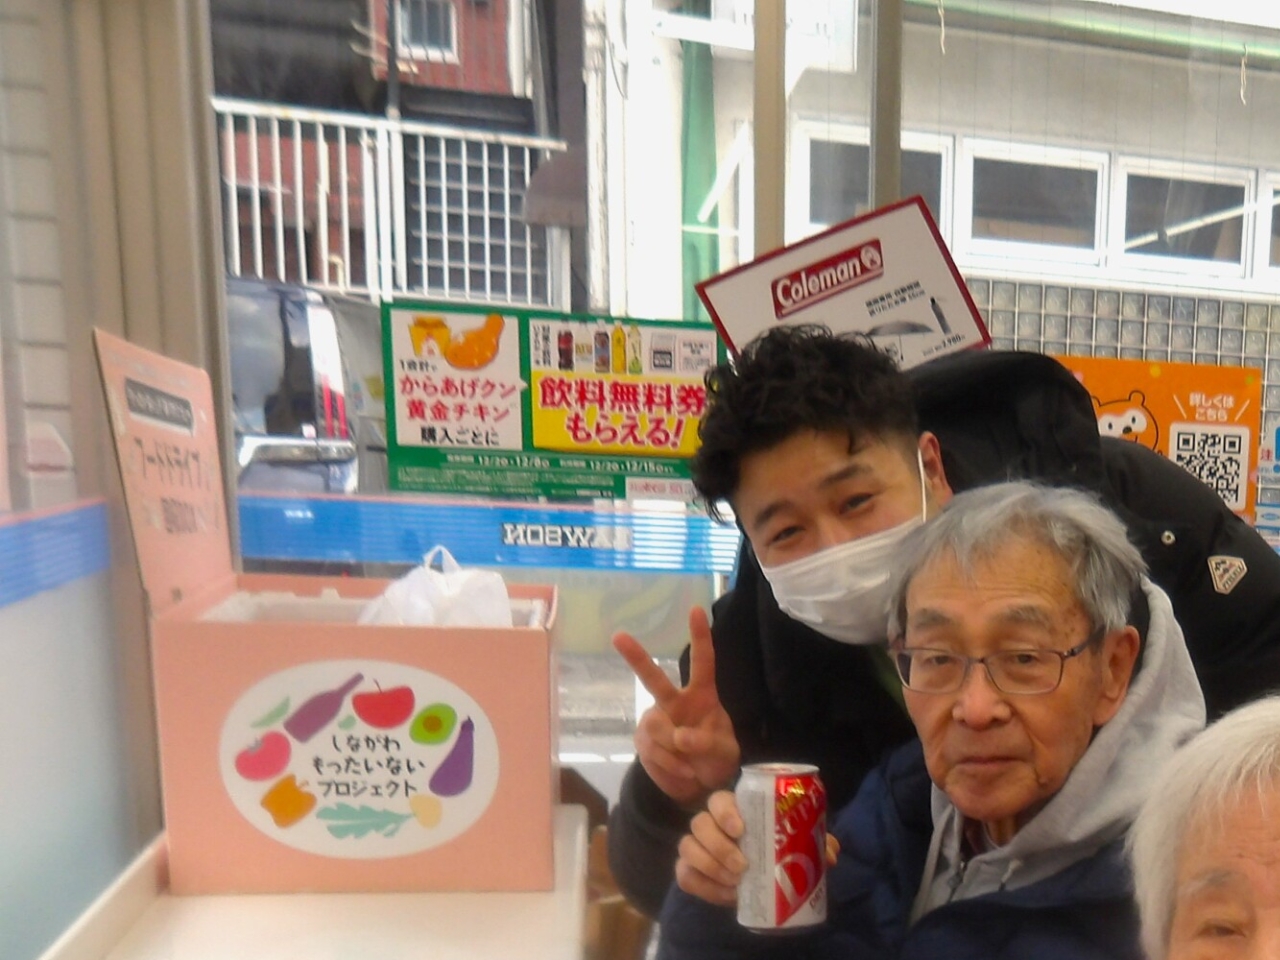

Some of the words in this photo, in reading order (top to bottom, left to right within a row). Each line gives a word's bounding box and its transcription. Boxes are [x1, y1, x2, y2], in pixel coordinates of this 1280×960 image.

[776, 256, 862, 307] Coleman
[400, 374, 517, 399] からあげクン
[540, 377, 707, 417] 飲料無料券
[1190, 392, 1234, 408] 詳しくは
[406, 399, 510, 423] 黄金チキン
[1195, 408, 1228, 421] こちら
[420, 425, 500, 446] 購入ごとに
[566, 412, 685, 448] もらえる!
[332, 734, 401, 751] しながわ
[312, 757, 425, 775] もったいない
[318, 780, 418, 798] プロジェクト
